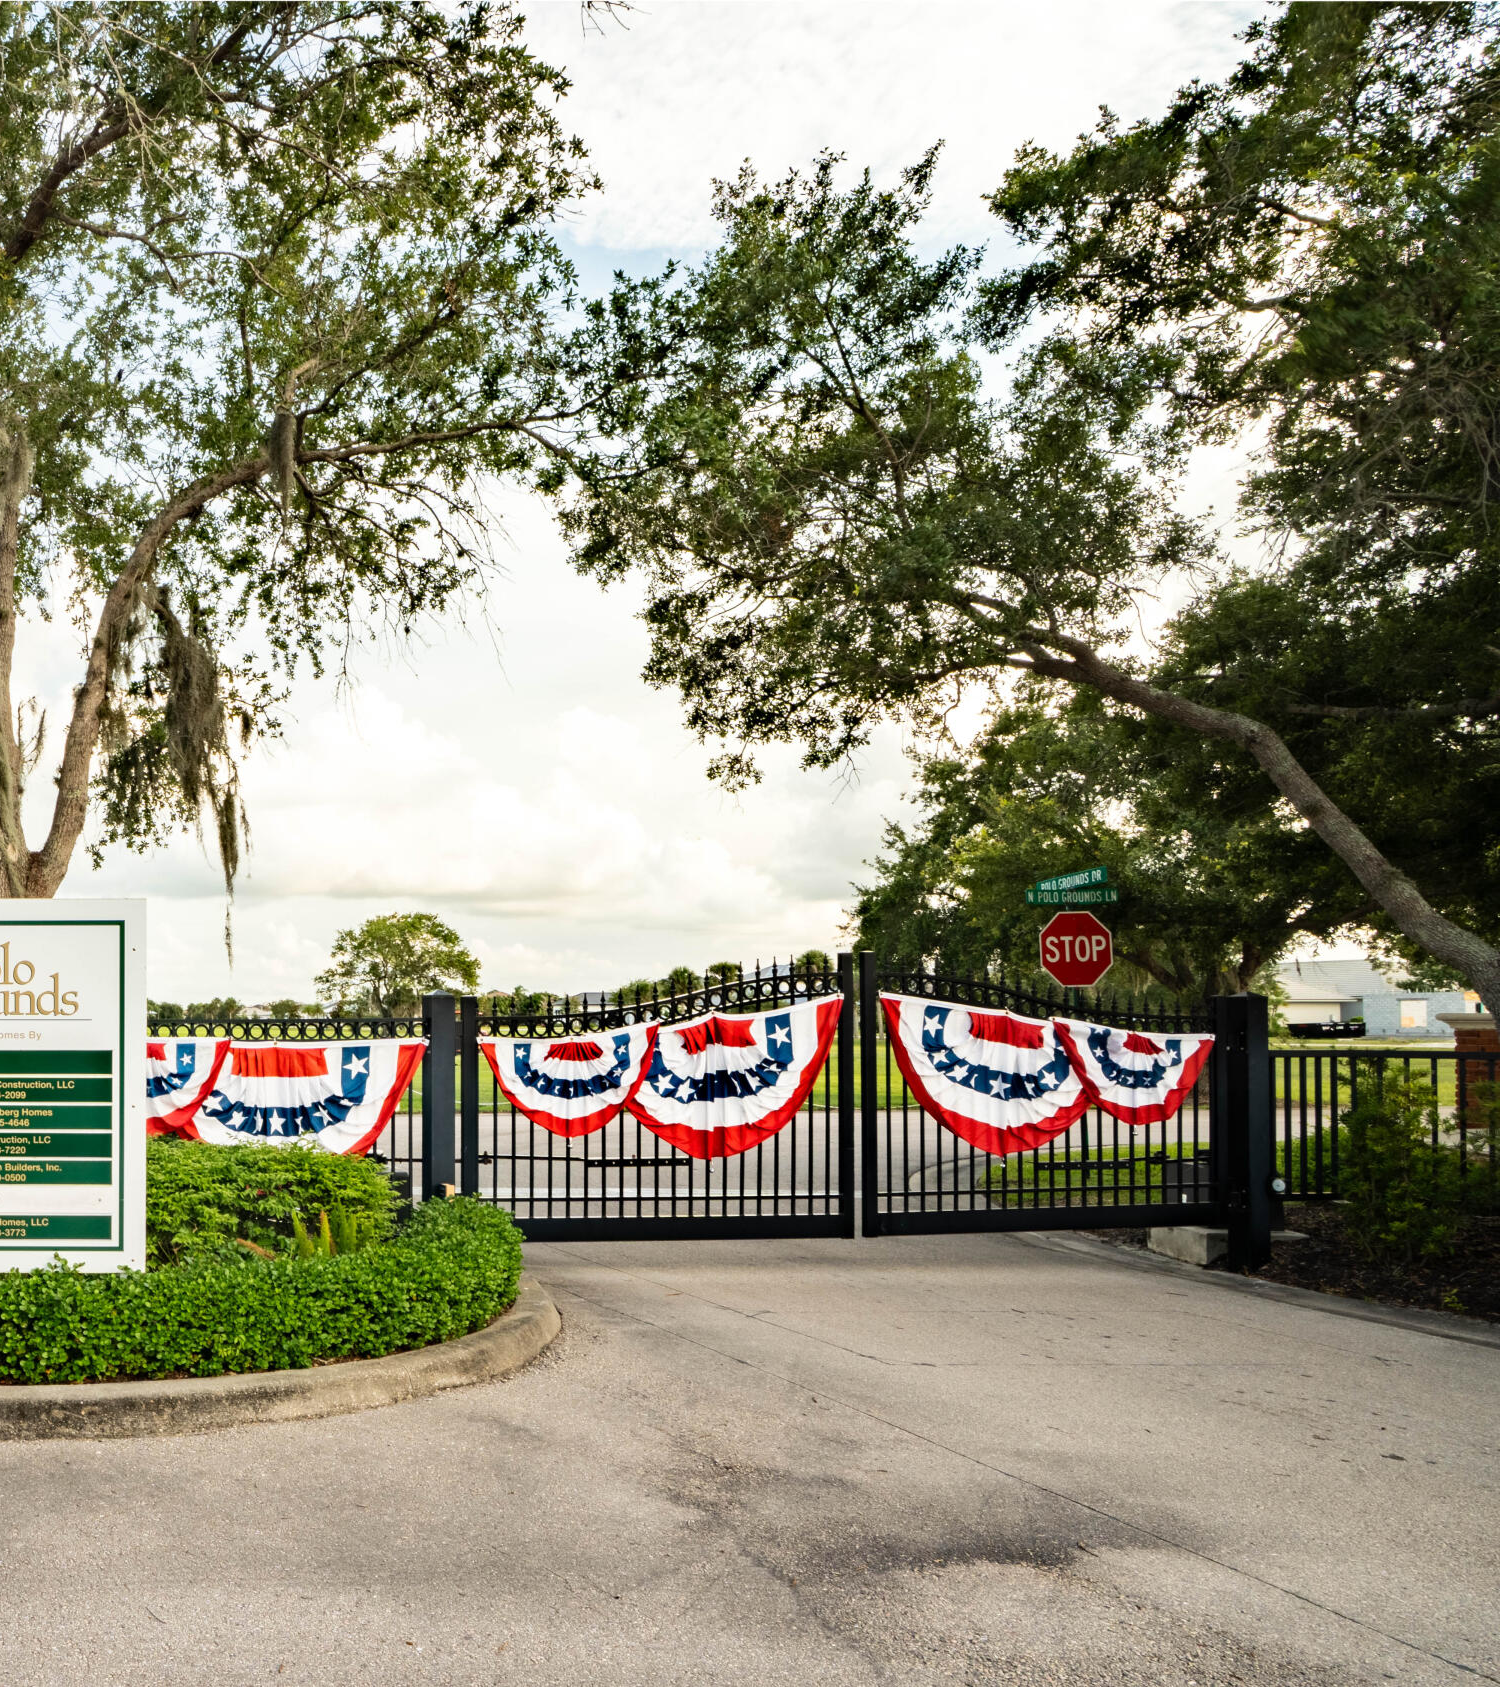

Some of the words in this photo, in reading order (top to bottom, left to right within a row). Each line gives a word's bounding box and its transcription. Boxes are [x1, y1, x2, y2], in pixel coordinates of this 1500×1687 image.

[1040, 880, 1057, 891] POLO
[1057, 872, 1089, 890] GROUNDS
[1091, 869, 1102, 882] DR
[1027, 891, 1034, 902] N
[1037, 891, 1059, 903] POLO
[1061, 891, 1102, 903] GROUNDS
[1105, 890, 1117, 902] LN
[1045, 935, 1107, 963] STOP
[28, 1030, 42, 1041] By
[56, 1080, 75, 1089] LLC
[21, 1107, 53, 1117] Homes
[32, 1135, 51, 1145] LLC
[4, 1162, 44, 1173] Builders,
[45, 1162, 63, 1172] Inc.
[30, 1217, 49, 1227] LLC
